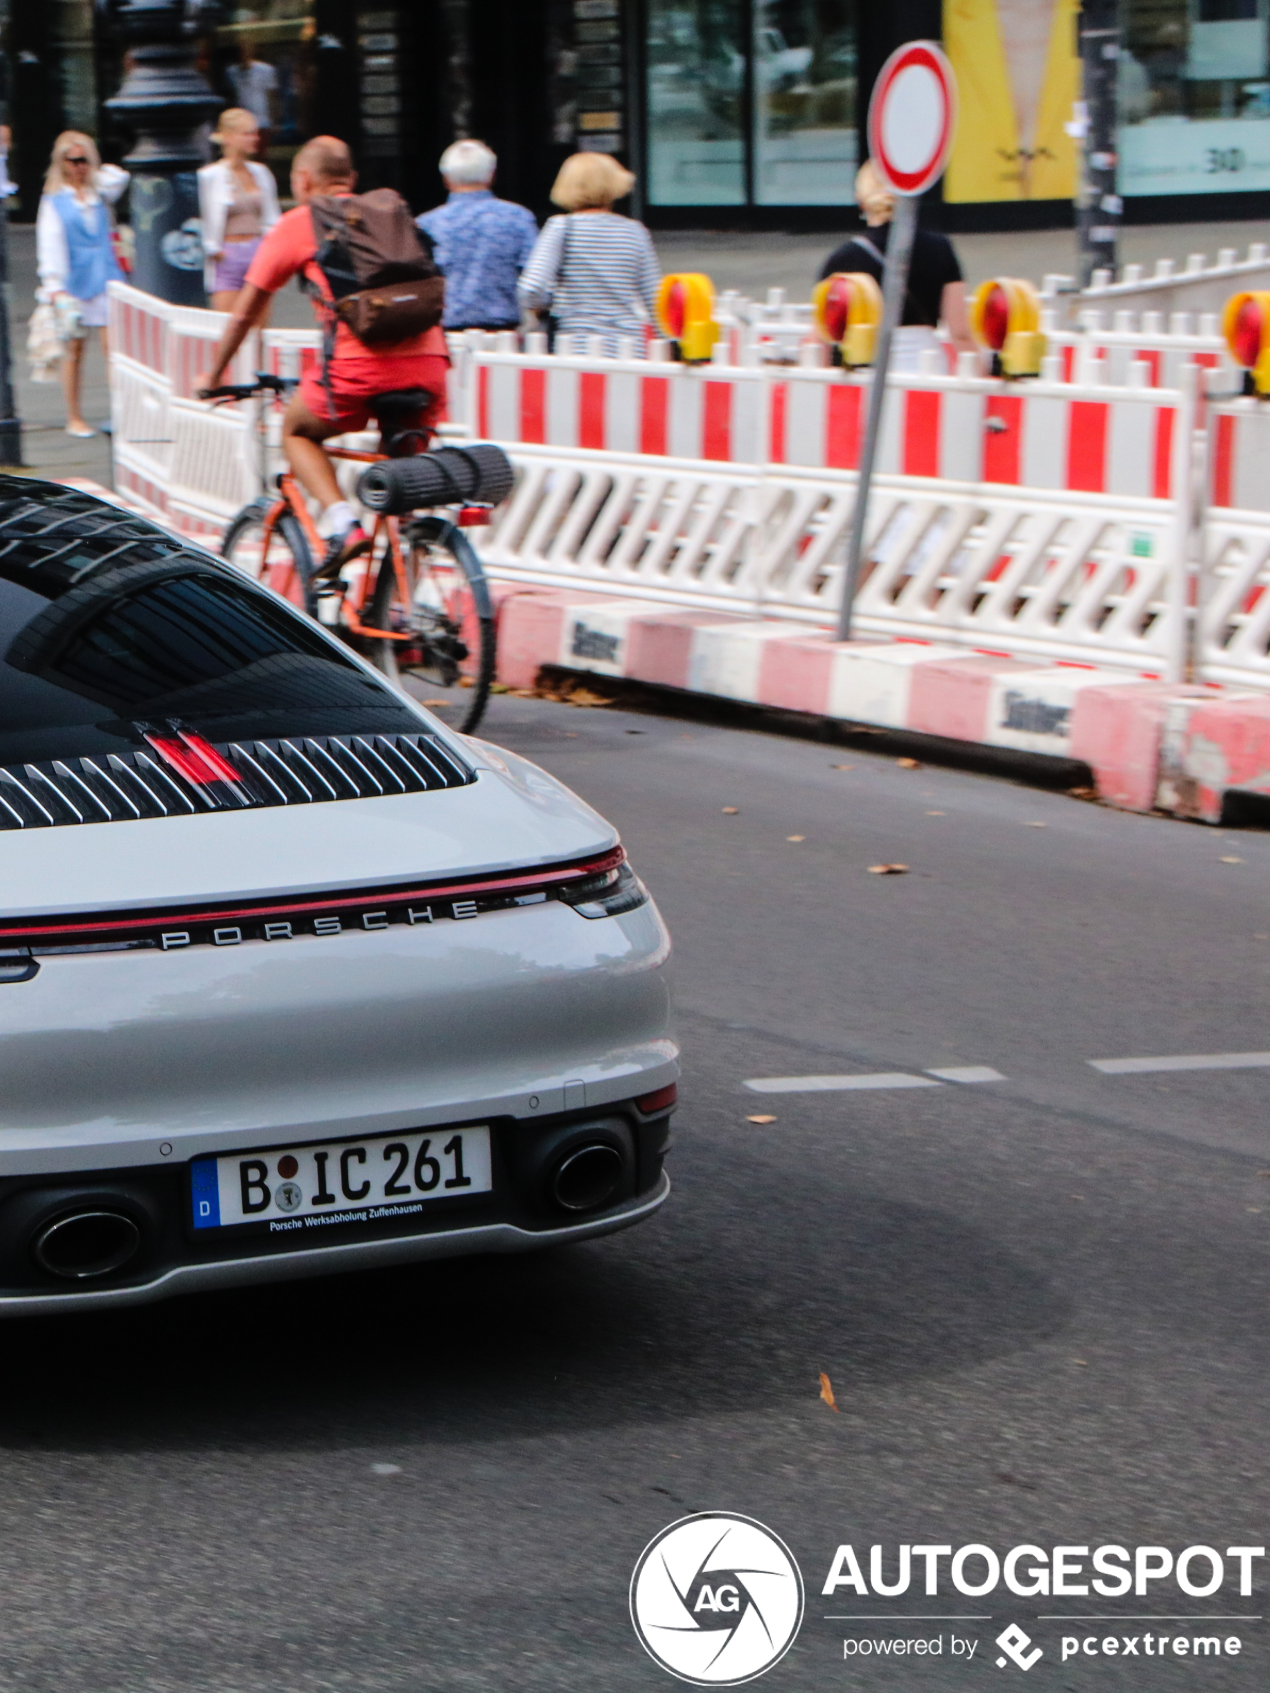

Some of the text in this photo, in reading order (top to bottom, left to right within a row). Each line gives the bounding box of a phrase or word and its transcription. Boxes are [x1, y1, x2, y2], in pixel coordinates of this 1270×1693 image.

[161, 900, 478, 950] PORSCHE
[239, 1135, 472, 1214] B IC 261
[199, 1201, 211, 1216] D
[269, 1203, 423, 1232] Porsche Werksabholung Zuffenhausen
